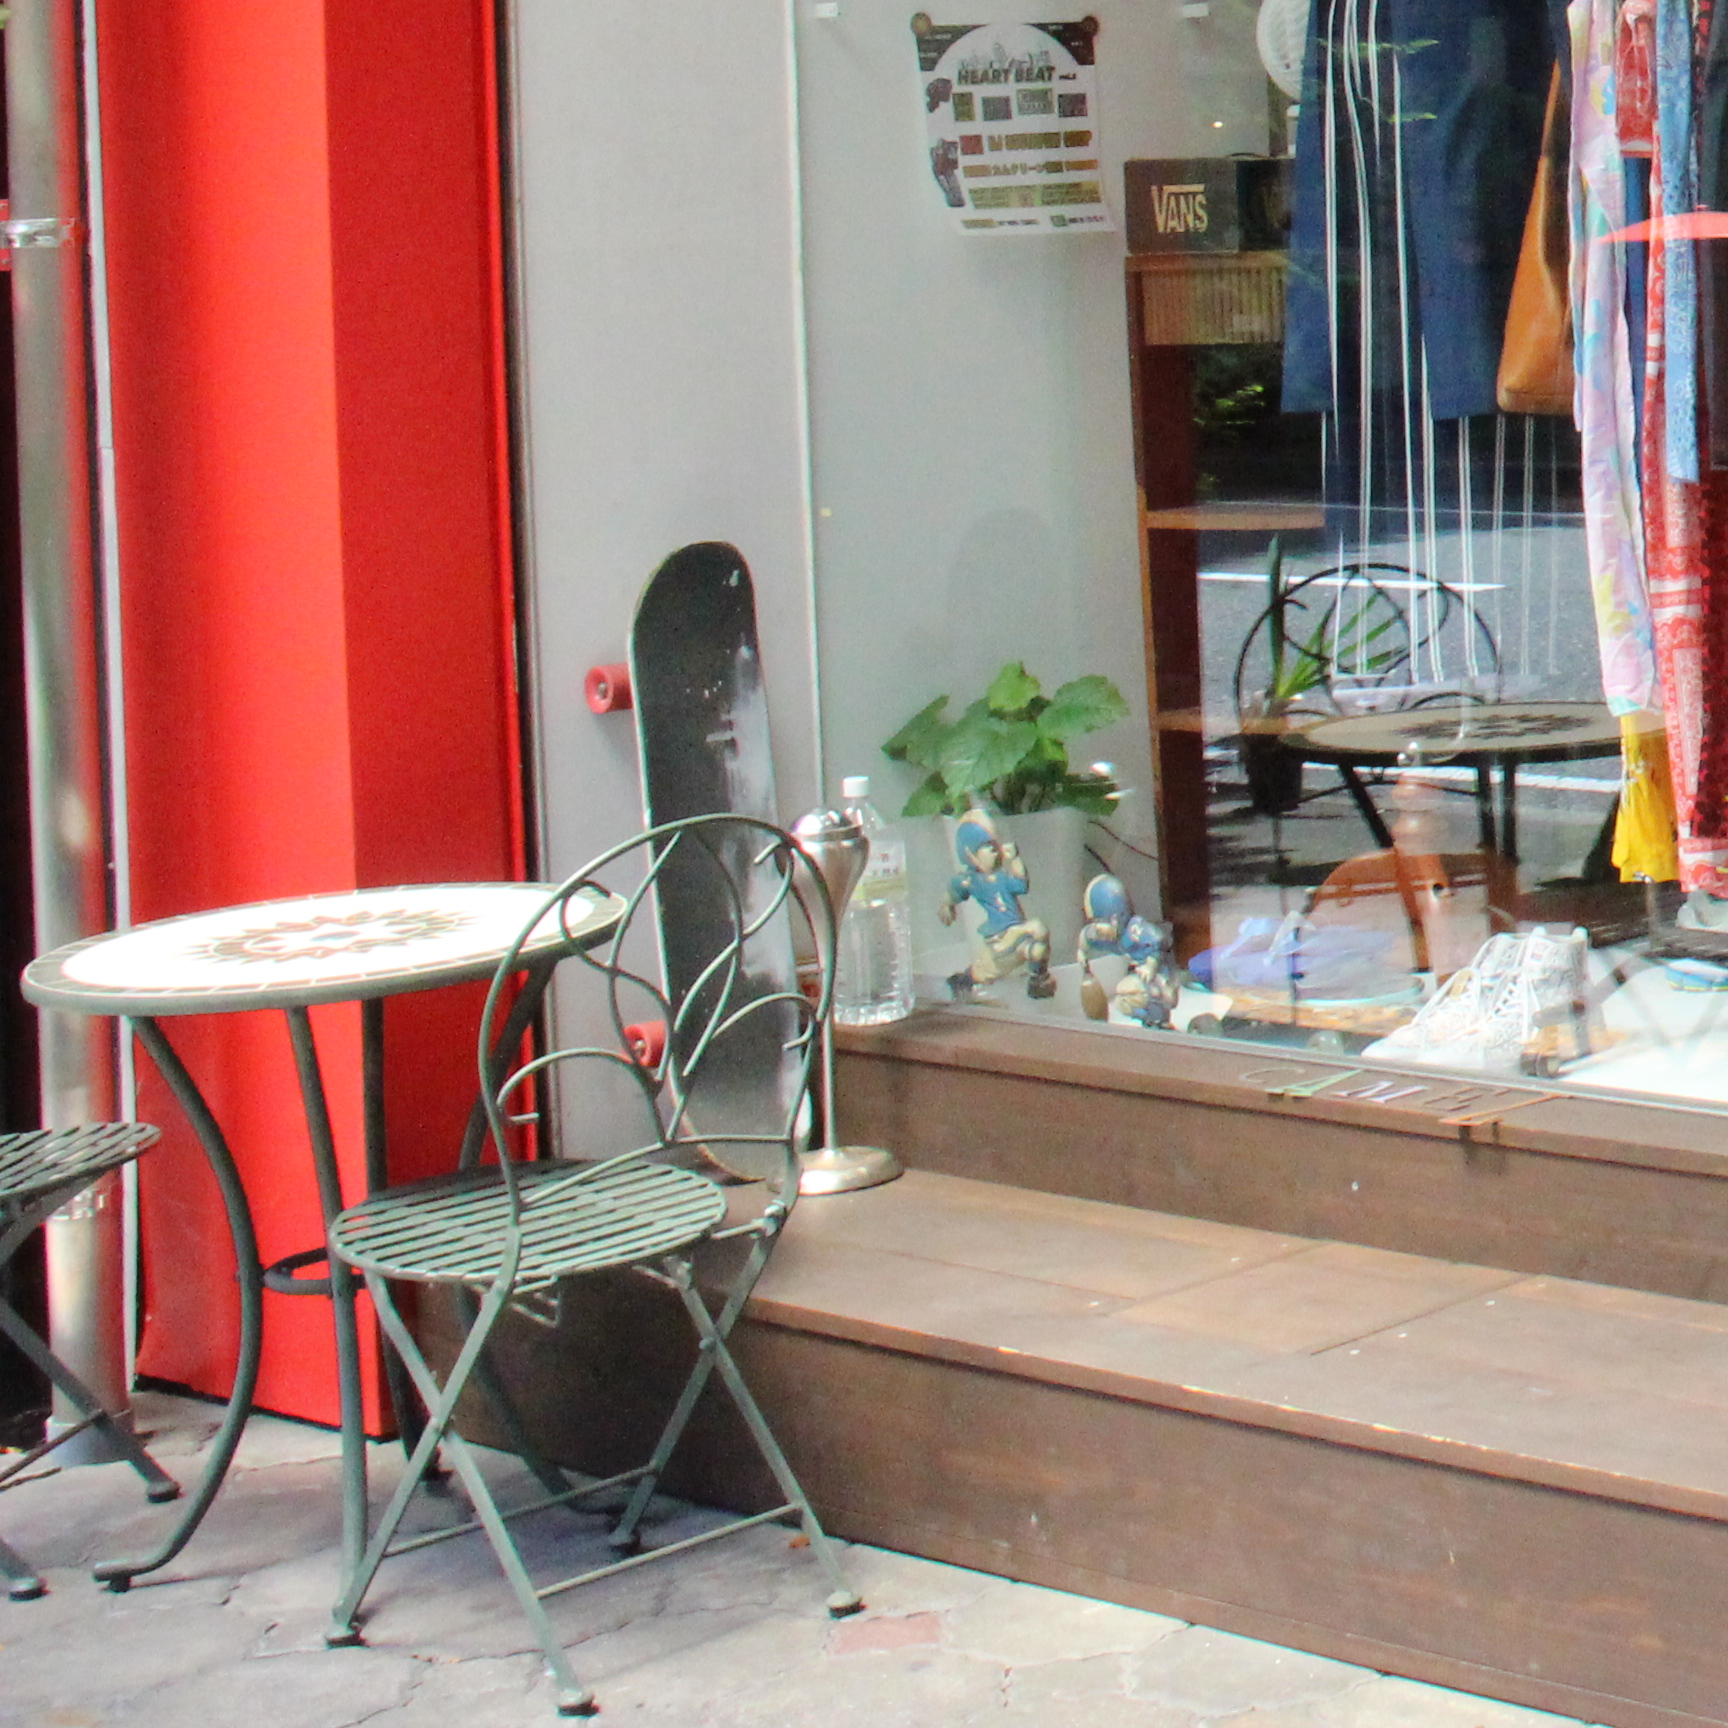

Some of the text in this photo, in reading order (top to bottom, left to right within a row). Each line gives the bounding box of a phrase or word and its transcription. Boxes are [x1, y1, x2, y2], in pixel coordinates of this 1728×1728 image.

[958, 67, 1010, 85] HEART
[1014, 65, 1056, 83] BEAT
[1150, 183, 1208, 233] VANS
